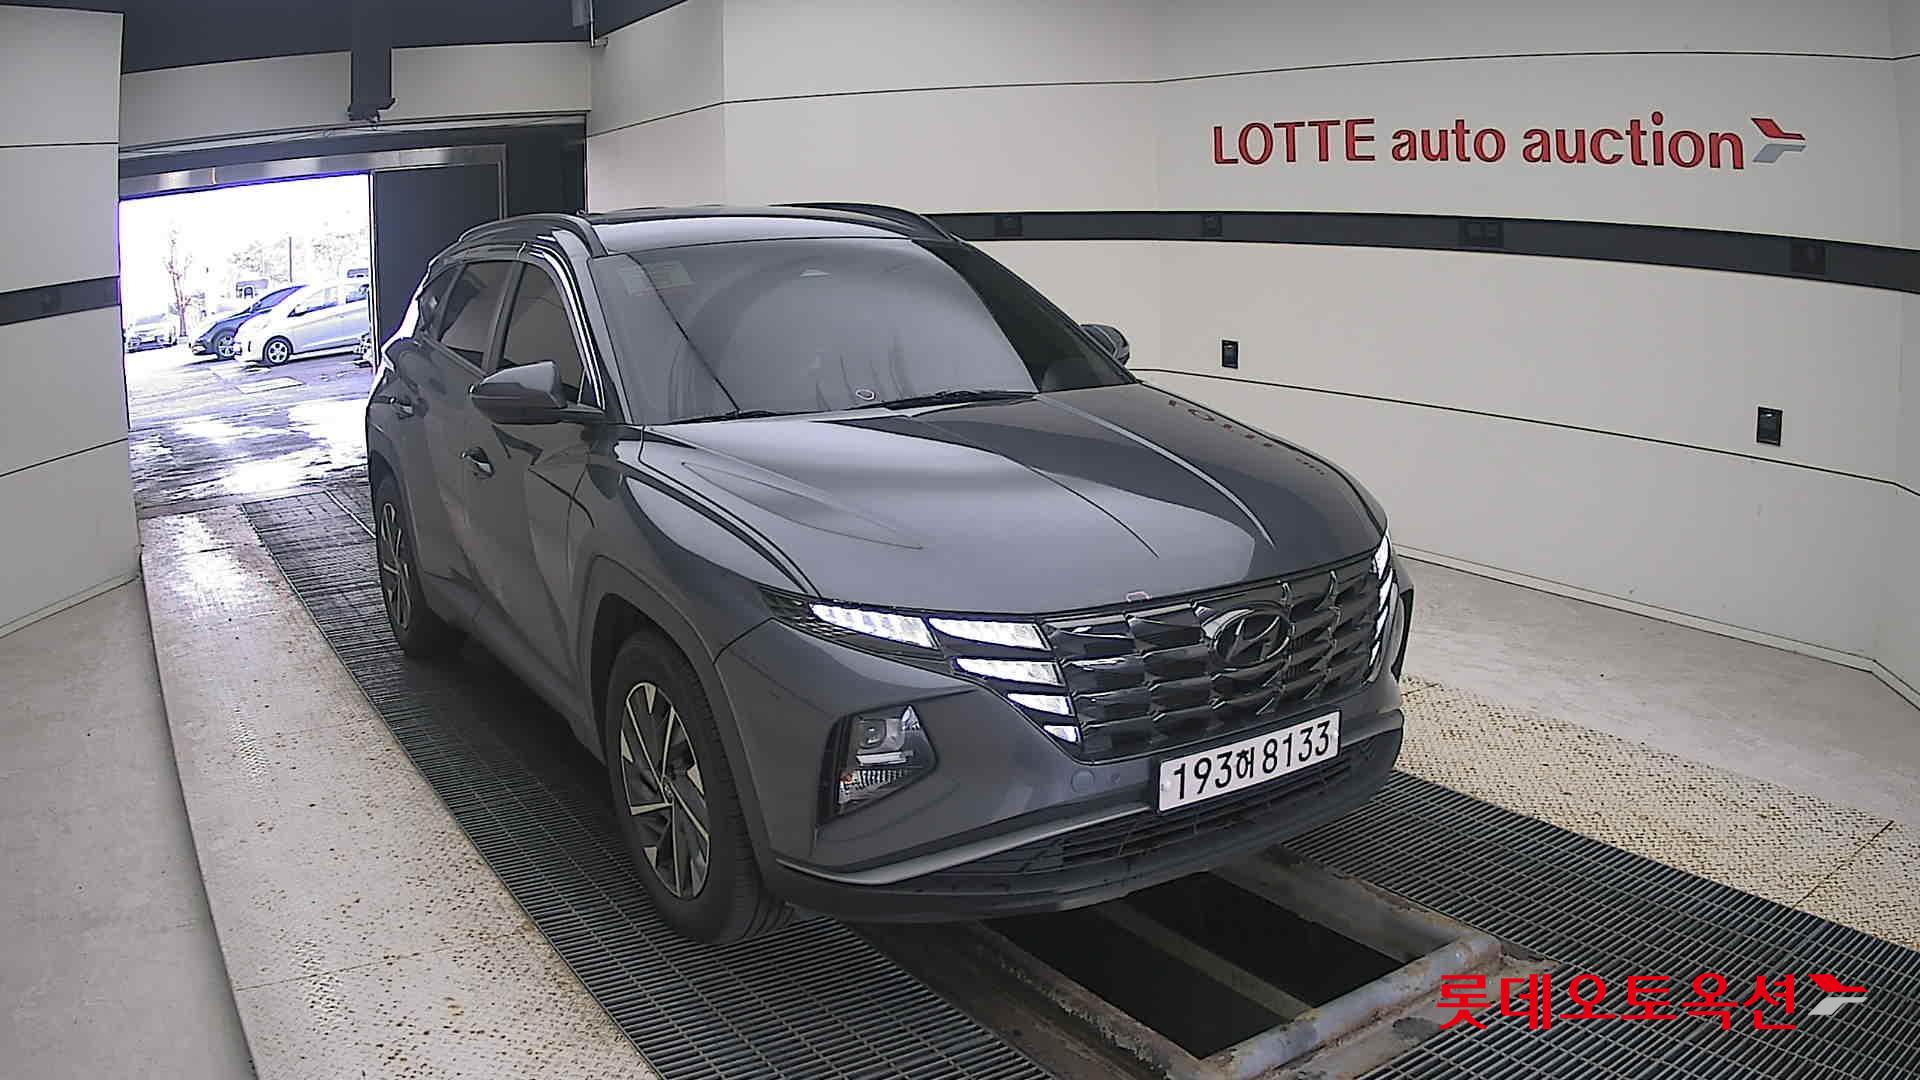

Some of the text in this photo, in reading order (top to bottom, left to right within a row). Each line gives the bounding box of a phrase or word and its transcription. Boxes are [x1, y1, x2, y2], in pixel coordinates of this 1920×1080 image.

[1213, 111, 1745, 170] LOTTE auto auction
[1262, 720, 1331, 774] 8133
